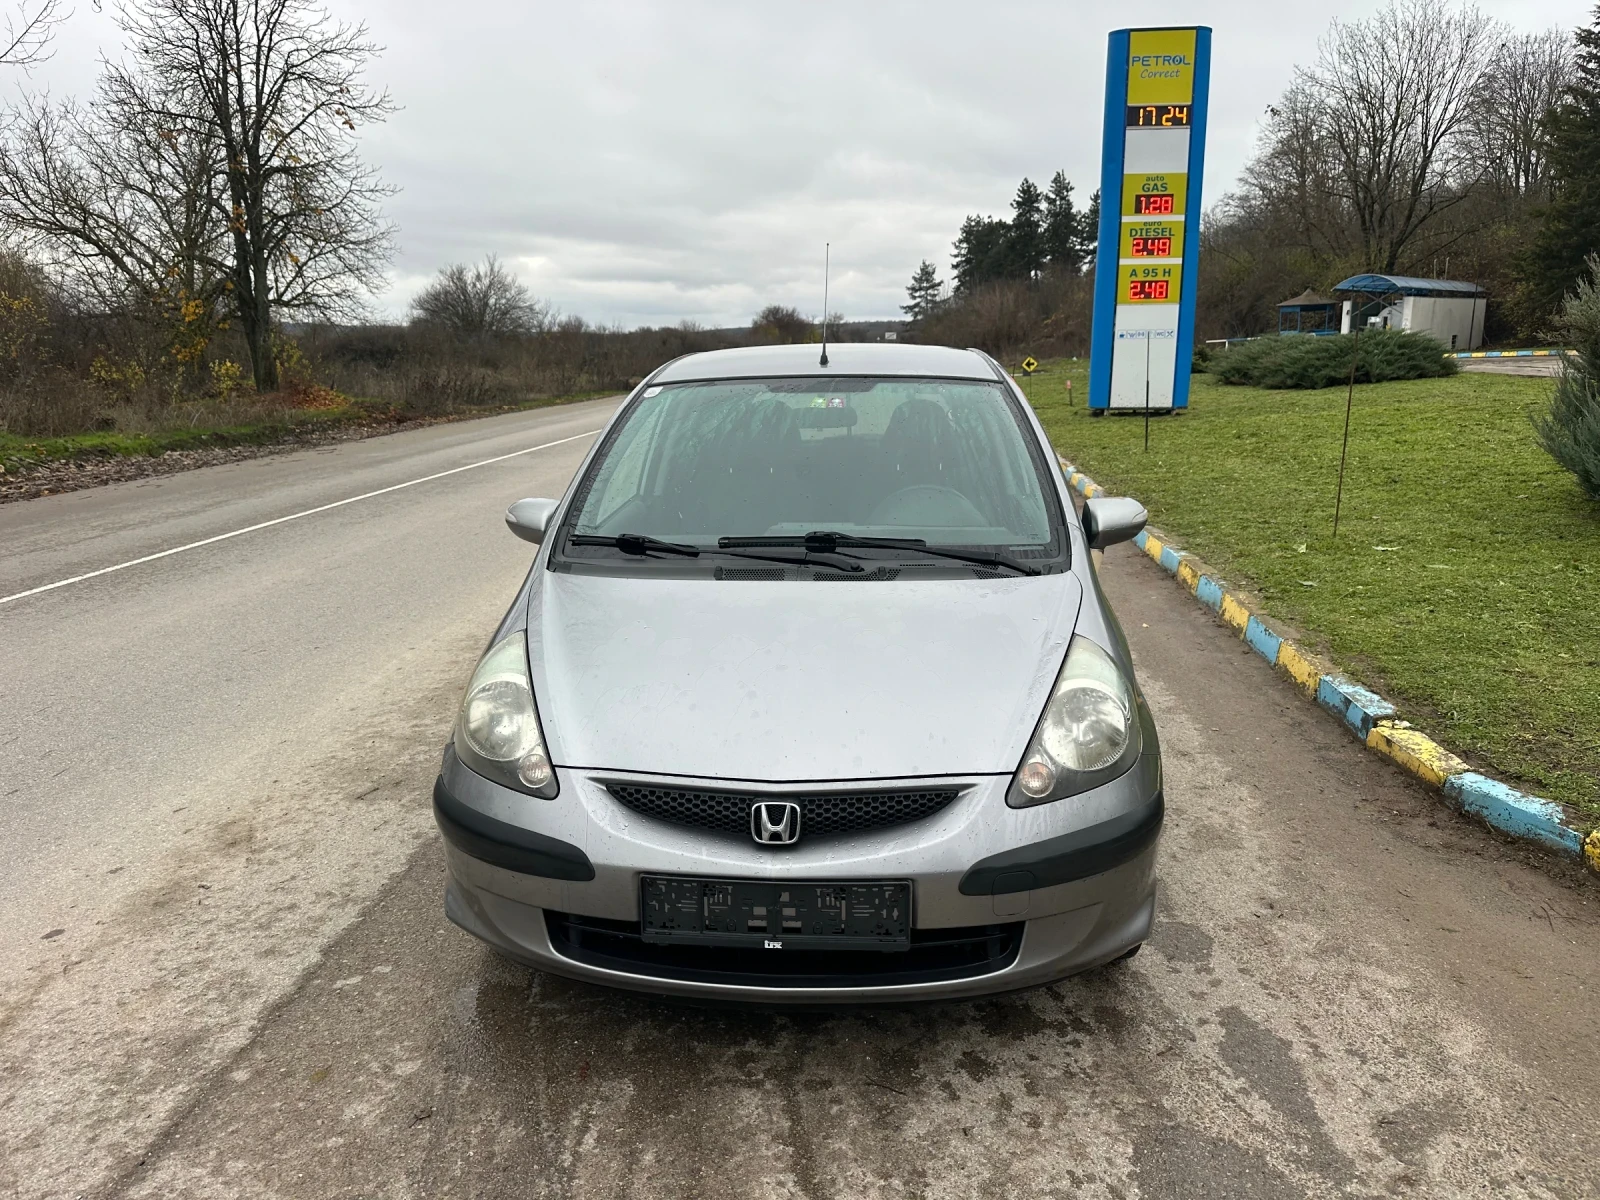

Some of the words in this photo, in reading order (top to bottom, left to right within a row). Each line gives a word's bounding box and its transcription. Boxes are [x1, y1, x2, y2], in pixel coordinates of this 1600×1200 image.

[1131, 55, 1190, 67] PETROL
[1140, 69, 1181, 79] Correct
[1141, 182, 1168, 193] GAS
[1129, 228, 1175, 237] DIESEL
[1132, 238, 1170, 256] 2.49
[1129, 268, 1138, 278] A
[1142, 268, 1158, 278] 95
[1163, 268, 1172, 278] H
[1129, 281, 1167, 299] 2.48
